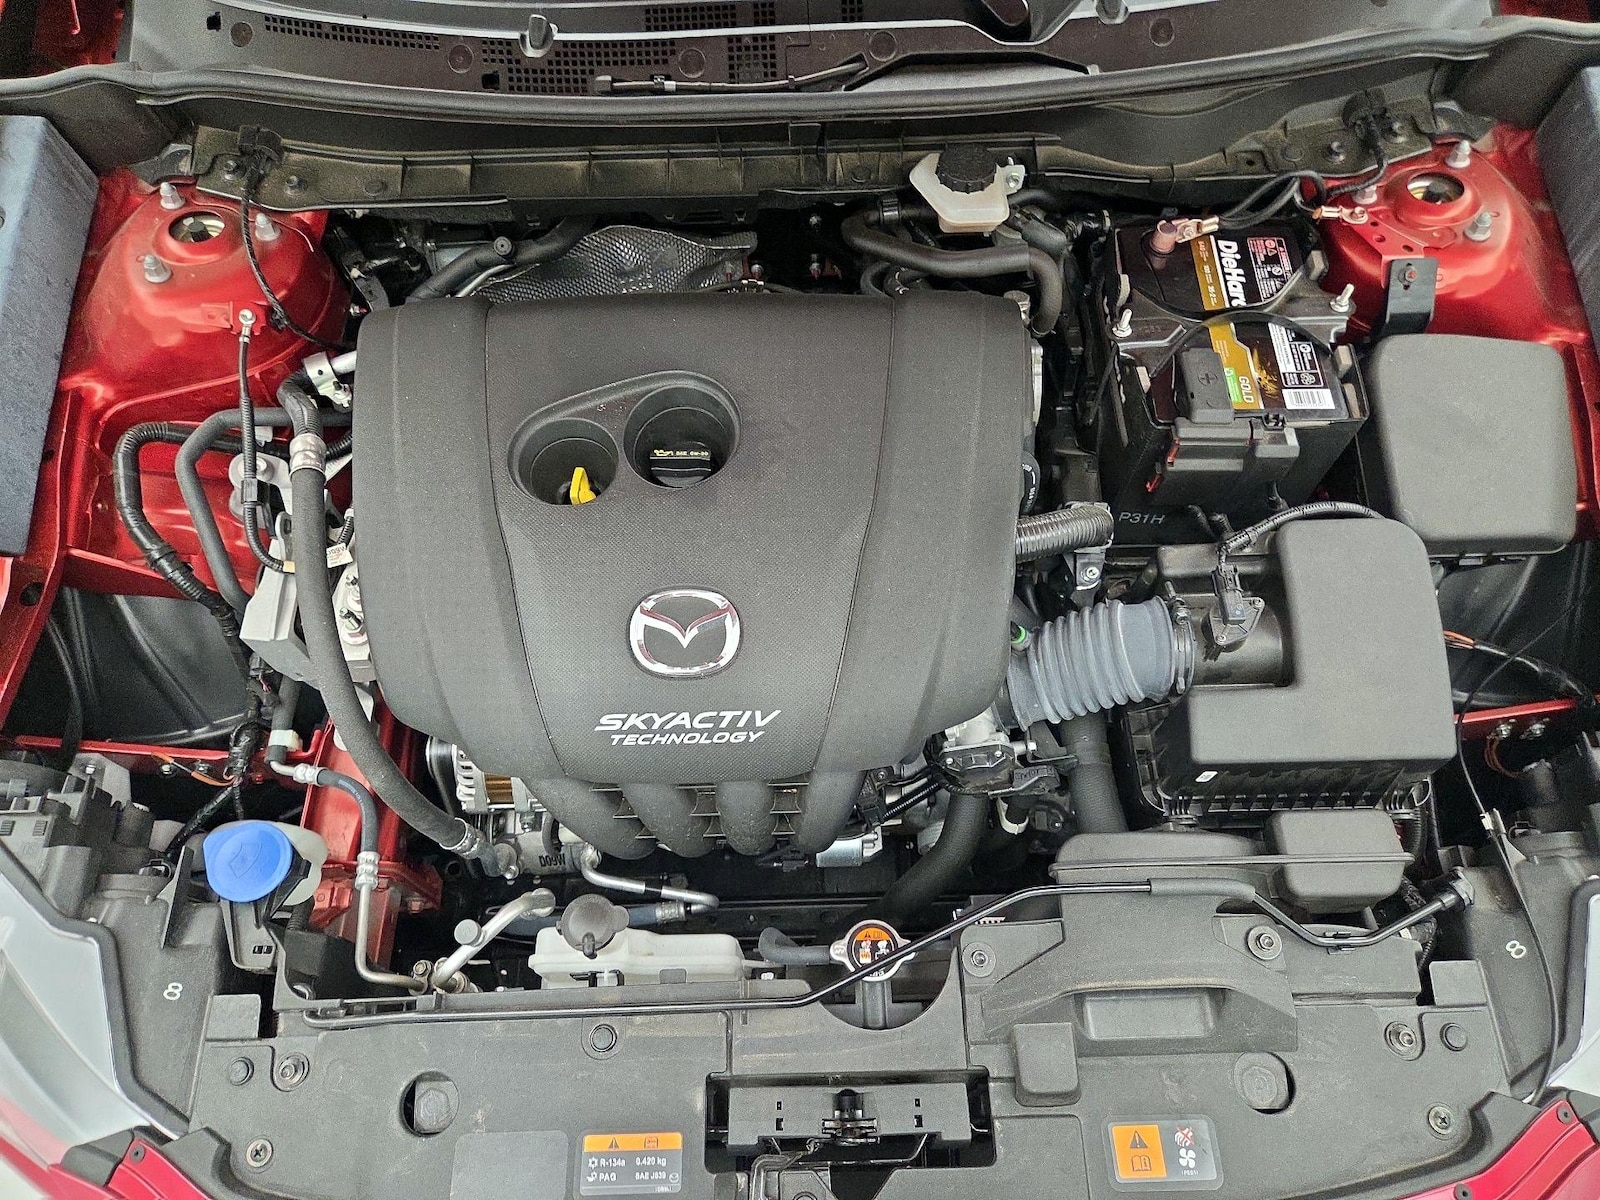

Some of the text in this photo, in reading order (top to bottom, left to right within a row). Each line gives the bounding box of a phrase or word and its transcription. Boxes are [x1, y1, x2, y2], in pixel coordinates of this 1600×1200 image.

[1239, 376, 1254, 403] GOLD
[1119, 511, 1165, 524] P31H
[594, 709, 782, 731] SKYACTIV
[610, 731, 765, 746] TECHNOLOGY
[656, 1156, 667, 1167] kg
